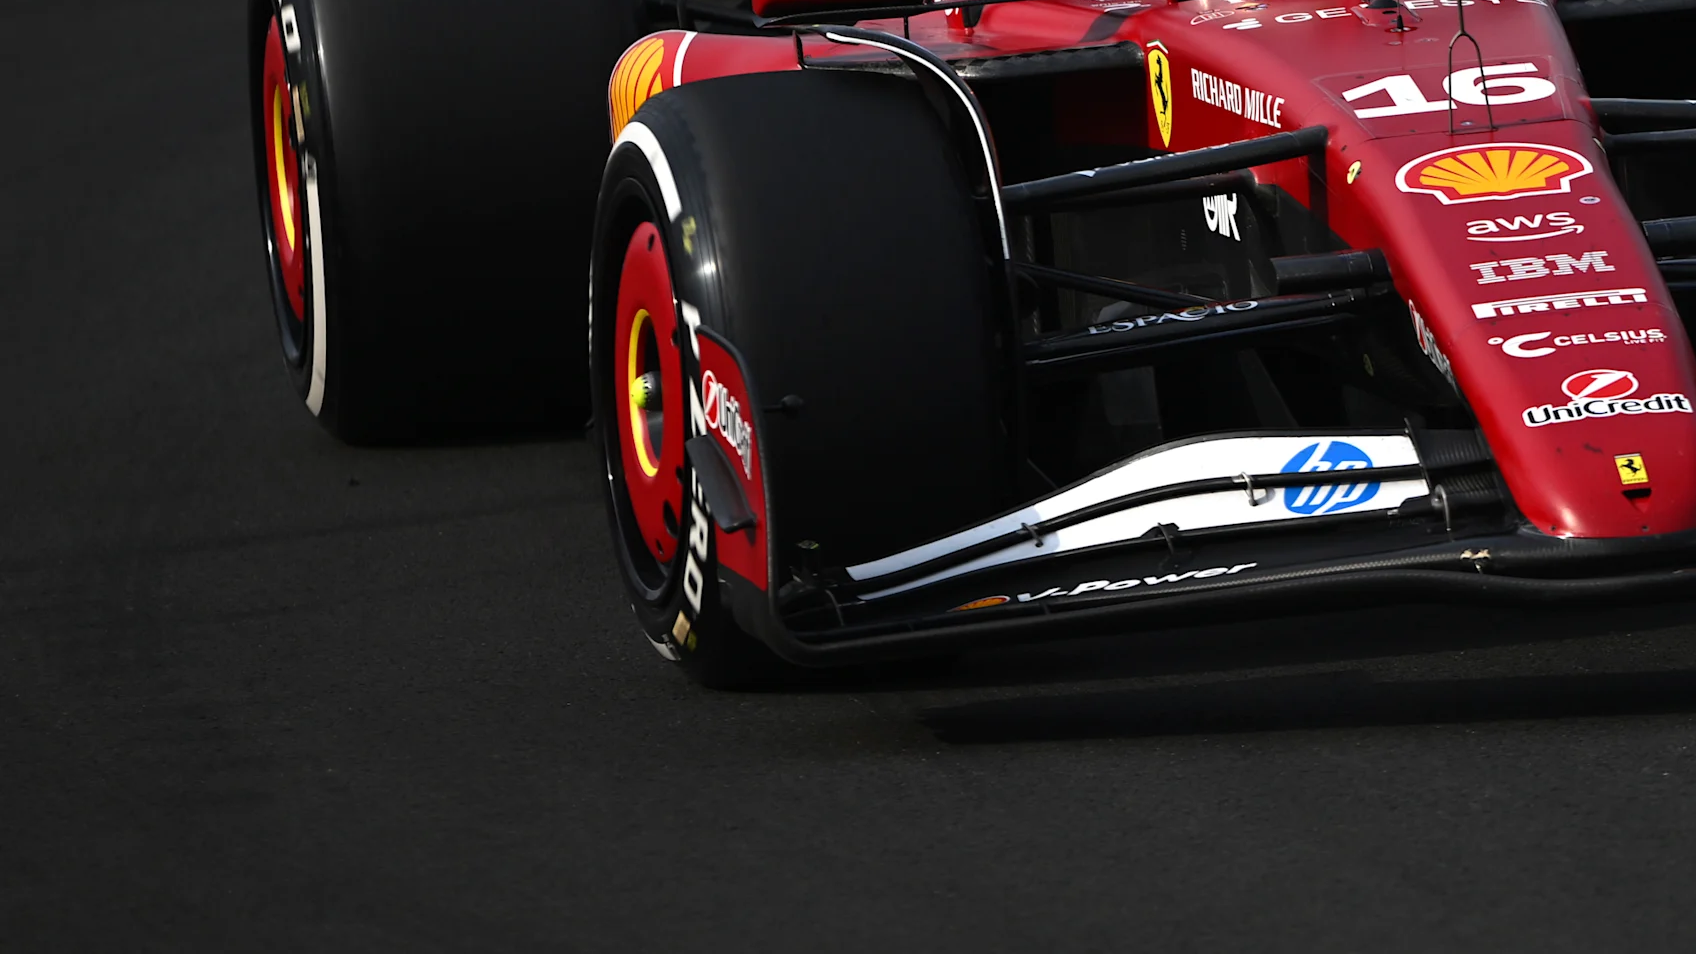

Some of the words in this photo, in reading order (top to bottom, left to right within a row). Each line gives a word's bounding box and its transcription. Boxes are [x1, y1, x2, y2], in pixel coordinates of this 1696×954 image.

[1190, 68, 1243, 116] RICHARD
[1243, 87, 1286, 129] MILLE
[1341, 62, 1557, 120] 16
[1466, 211, 1577, 236] aws
[1469, 250, 1616, 285] IBM
[1470, 287, 1649, 320] PIRELLI
[1553, 328, 1664, 346] CELSIUS
[1526, 396, 1690, 426] UniCredit
[1017, 562, 1257, 602] V-Power
